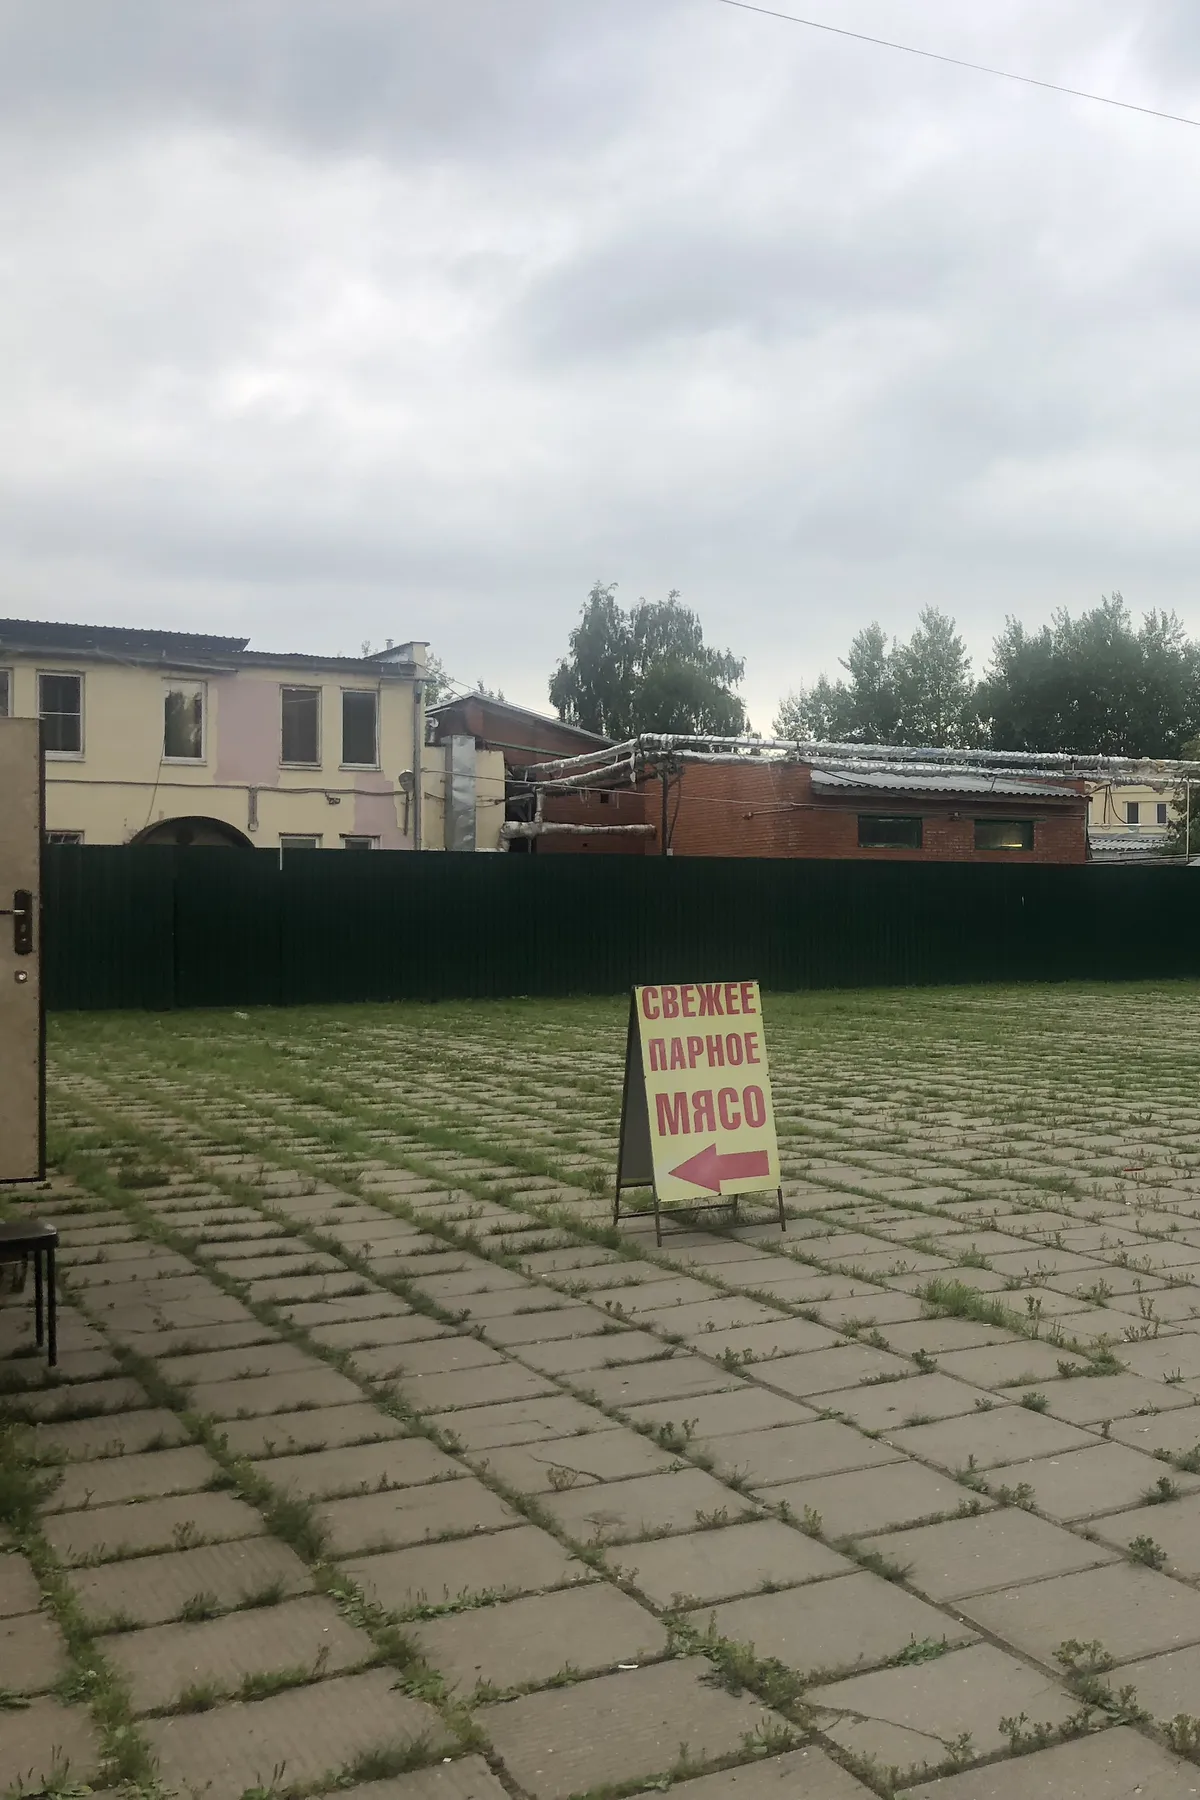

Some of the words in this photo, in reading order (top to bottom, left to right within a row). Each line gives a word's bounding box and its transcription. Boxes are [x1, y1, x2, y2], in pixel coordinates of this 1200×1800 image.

[641, 983, 757, 1020] СВЕЖЕЕ
[648, 1031, 761, 1072] ПАРНОЕ
[655, 1084, 767, 1137] МЯСО
